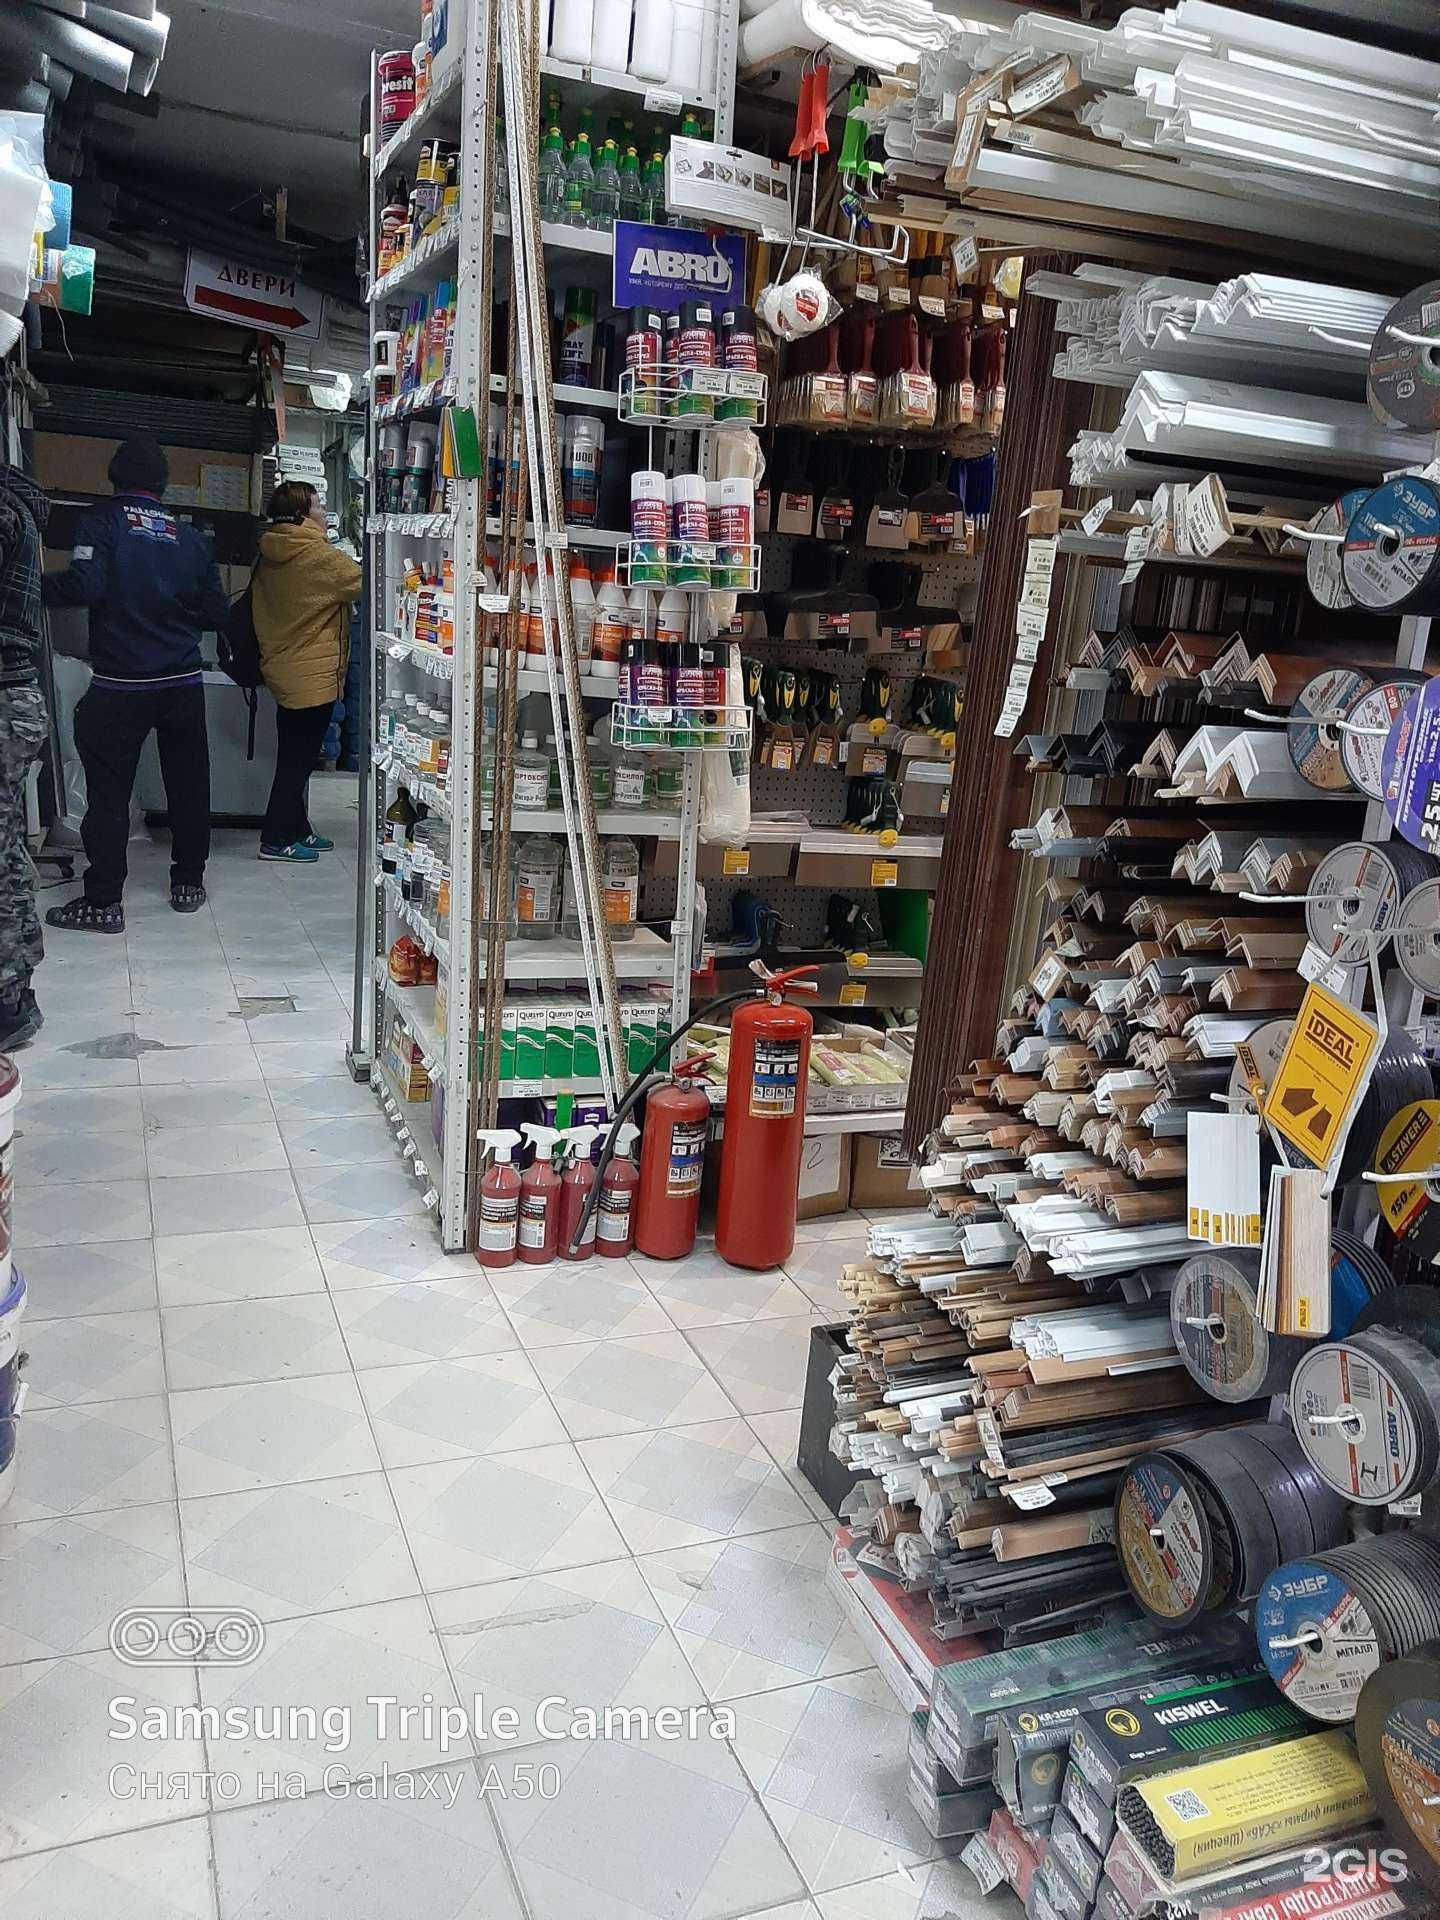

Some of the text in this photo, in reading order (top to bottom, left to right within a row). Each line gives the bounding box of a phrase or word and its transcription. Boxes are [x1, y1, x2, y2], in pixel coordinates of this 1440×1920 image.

[629, 247, 729, 284] ABRO
[217, 263, 296, 298] ДВЕРИ
[1402, 490, 1437, 519] ЗУБР
[1420, 802, 1440, 841] 25
[519, 1011, 545, 1021] QUELYD
[548, 1010, 574, 1020] QUELYD
[631, 1008, 656, 1018] QUELYD
[1306, 1015, 1355, 1065] IDEAL
[1240, 1045, 1256, 1079] IDEAL
[807, 1142, 825, 1170] 2
[1391, 1122, 1423, 1163] STAYER
[1390, 1189, 1409, 1217] 150
[1387, 1411, 1400, 1458] ABRO
[1281, 1575, 1329, 1599] ЗУБР
[1336, 1643, 1374, 1659] МЕТАЛЛ
[1153, 1698, 1225, 1726] KISWEL
